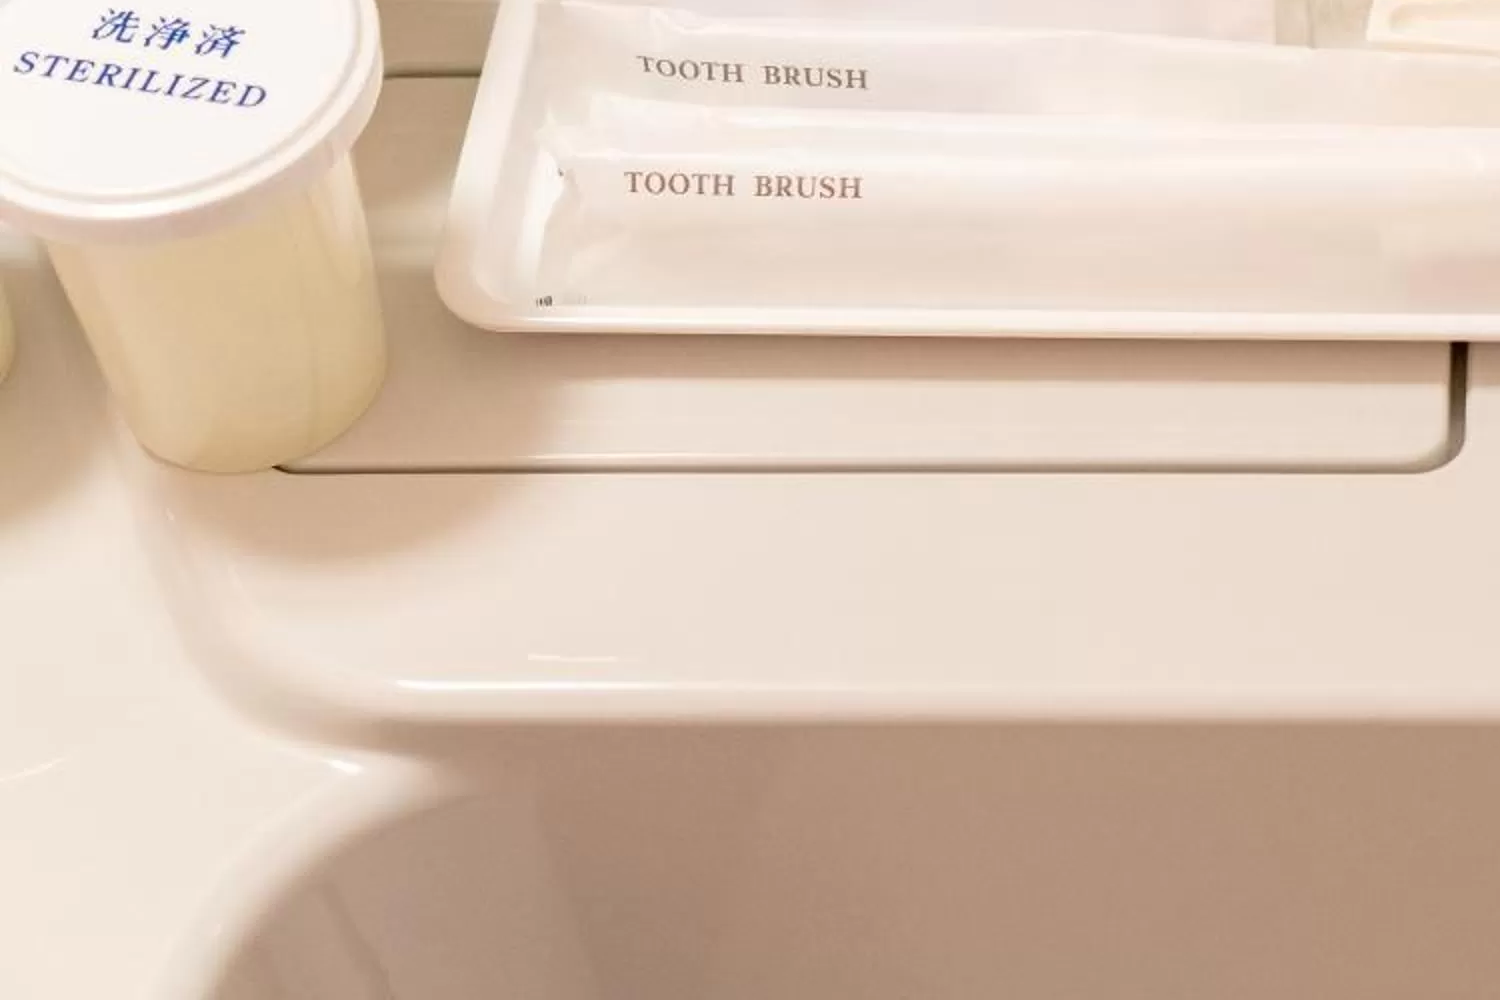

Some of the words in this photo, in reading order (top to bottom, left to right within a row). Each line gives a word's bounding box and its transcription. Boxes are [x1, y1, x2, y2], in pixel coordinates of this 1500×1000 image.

[91, 8, 245, 58] 洗浄済
[13, 51, 267, 107] STERILIZED
[636, 55, 745, 83] TOOTH
[763, 65, 868, 90] BRUSH
[624, 171, 735, 196] TOOTH
[753, 175, 863, 199] BRUSH
